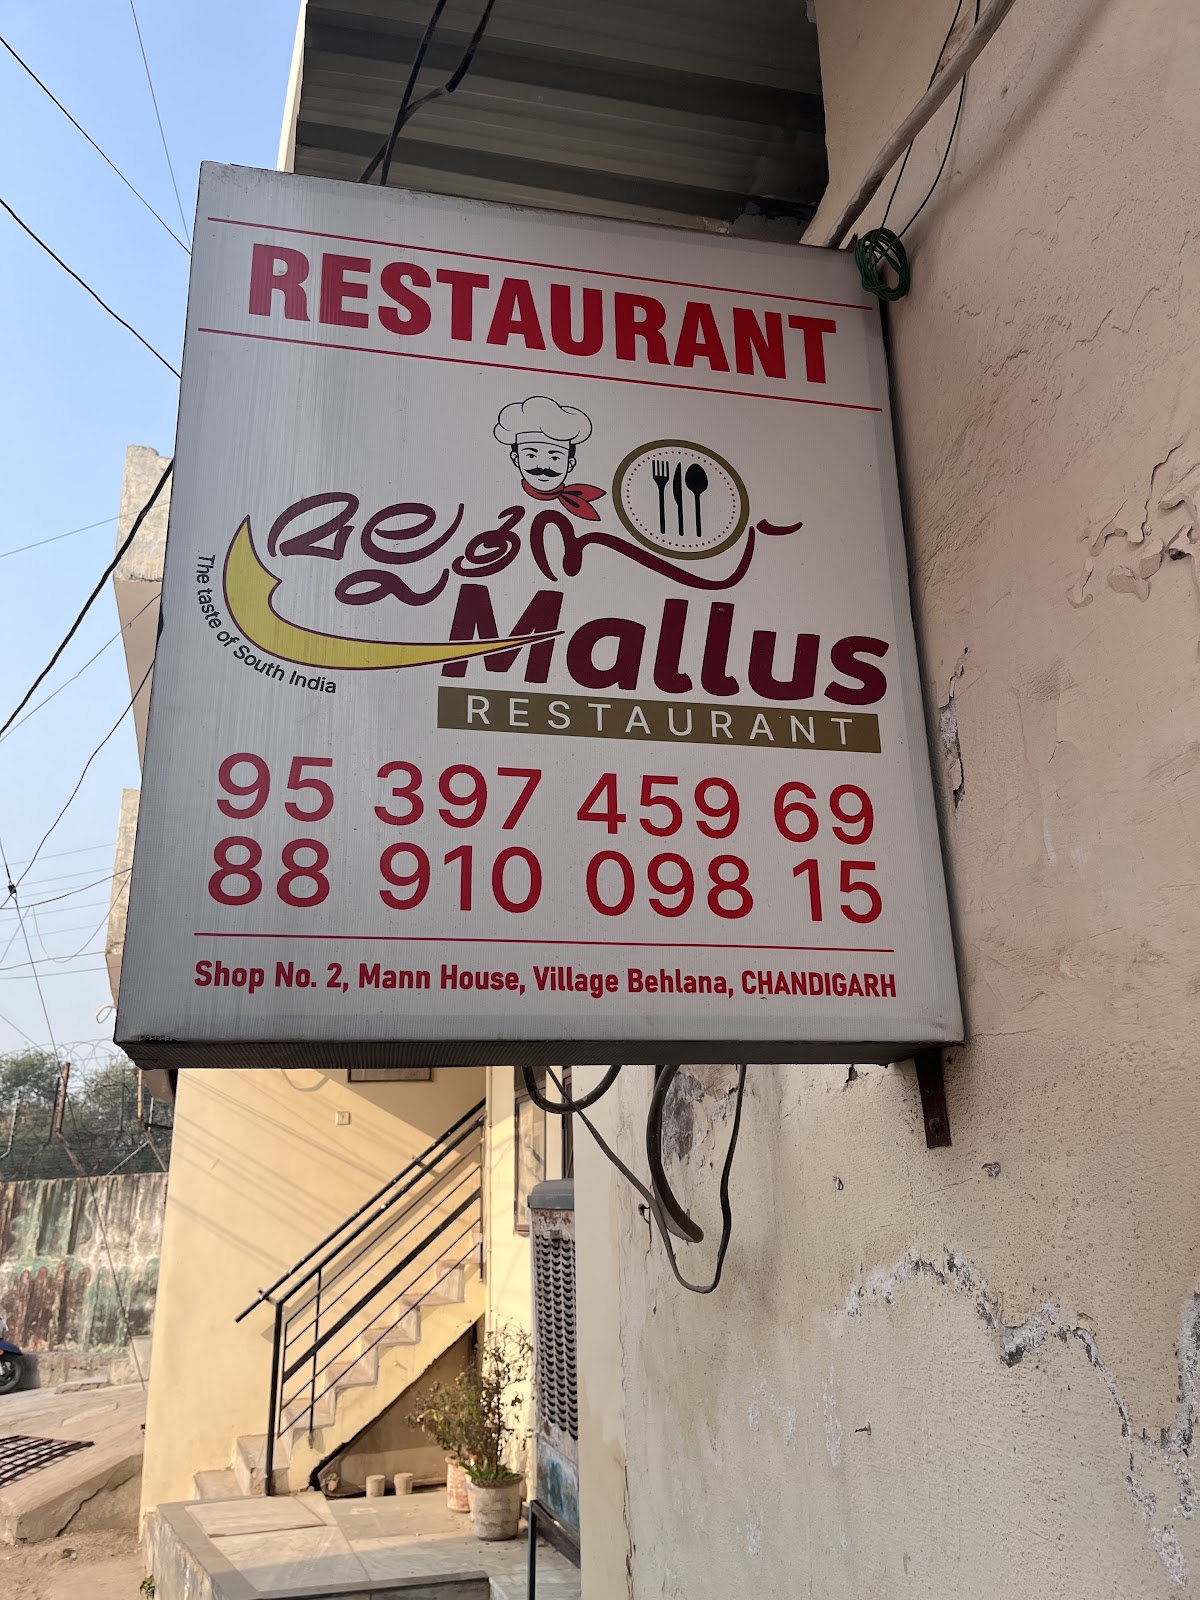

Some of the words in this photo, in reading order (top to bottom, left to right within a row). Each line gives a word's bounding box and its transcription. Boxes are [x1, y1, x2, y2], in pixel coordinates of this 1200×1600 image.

[249, 244, 837, 385] RESTAURANT
[196, 554, 216, 584] The
[197, 587, 222, 629] taste
[216, 630, 240, 648] of
[440, 583, 890, 706] Mallus
[233, 644, 286, 682] South
[289, 670, 337, 694] India
[466, 694, 854, 747] RESTAURANT
[216, 753, 335, 823] 95
[373, 760, 543, 831] 397
[576, 772, 741, 840] 459
[773, 780, 875, 846] 69
[208, 836, 331, 908] 88
[379, 841, 543, 914] 910
[585, 849, 755, 920] 098
[792, 858, 883, 924] 15
[194, 960, 265, 994] Shop
[275, 961, 317, 989] No.
[326, 962, 349, 993] 2,
[358, 963, 431, 990] Mann
[440, 964, 526, 995] House,
[533, 965, 619, 999] Village
[627, 967, 735, 998] Behlana,
[741, 969, 897, 998] CHANDIGARH
